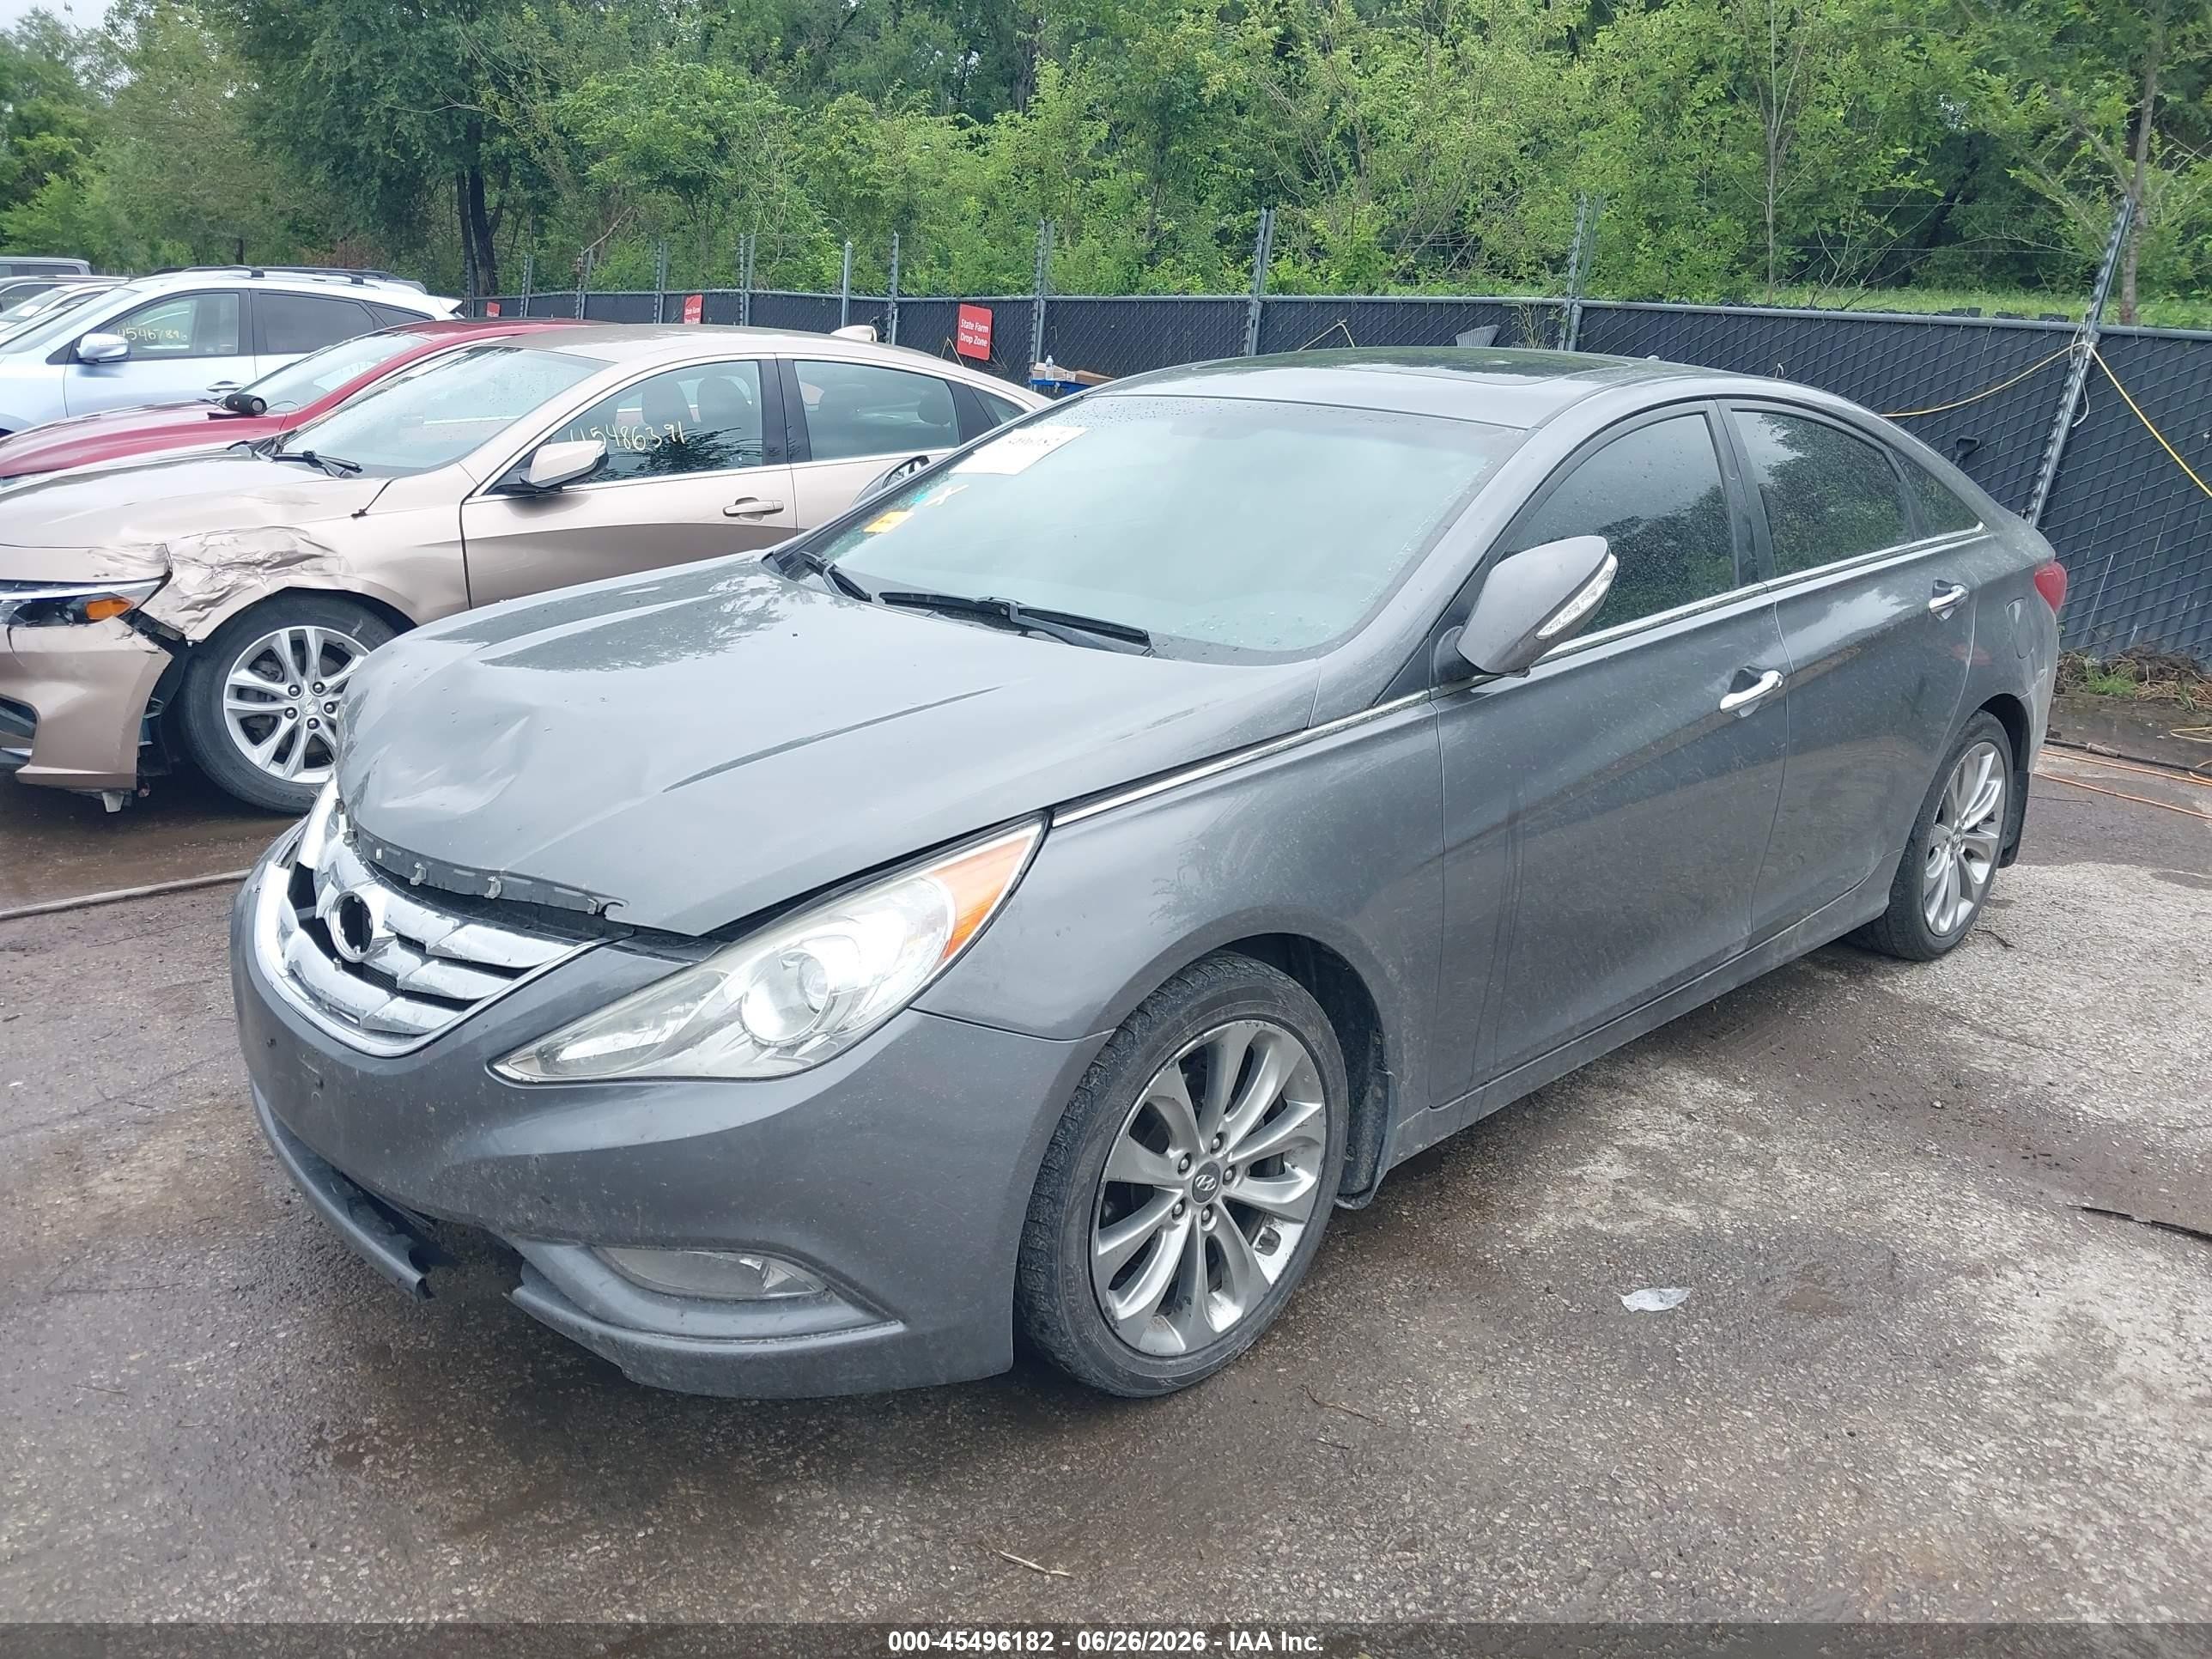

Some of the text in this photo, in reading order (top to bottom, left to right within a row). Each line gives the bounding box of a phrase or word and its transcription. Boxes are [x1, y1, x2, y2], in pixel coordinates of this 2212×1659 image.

[960, 319, 989, 333] State Farm
[960, 332, 988, 347] Drop Zone
